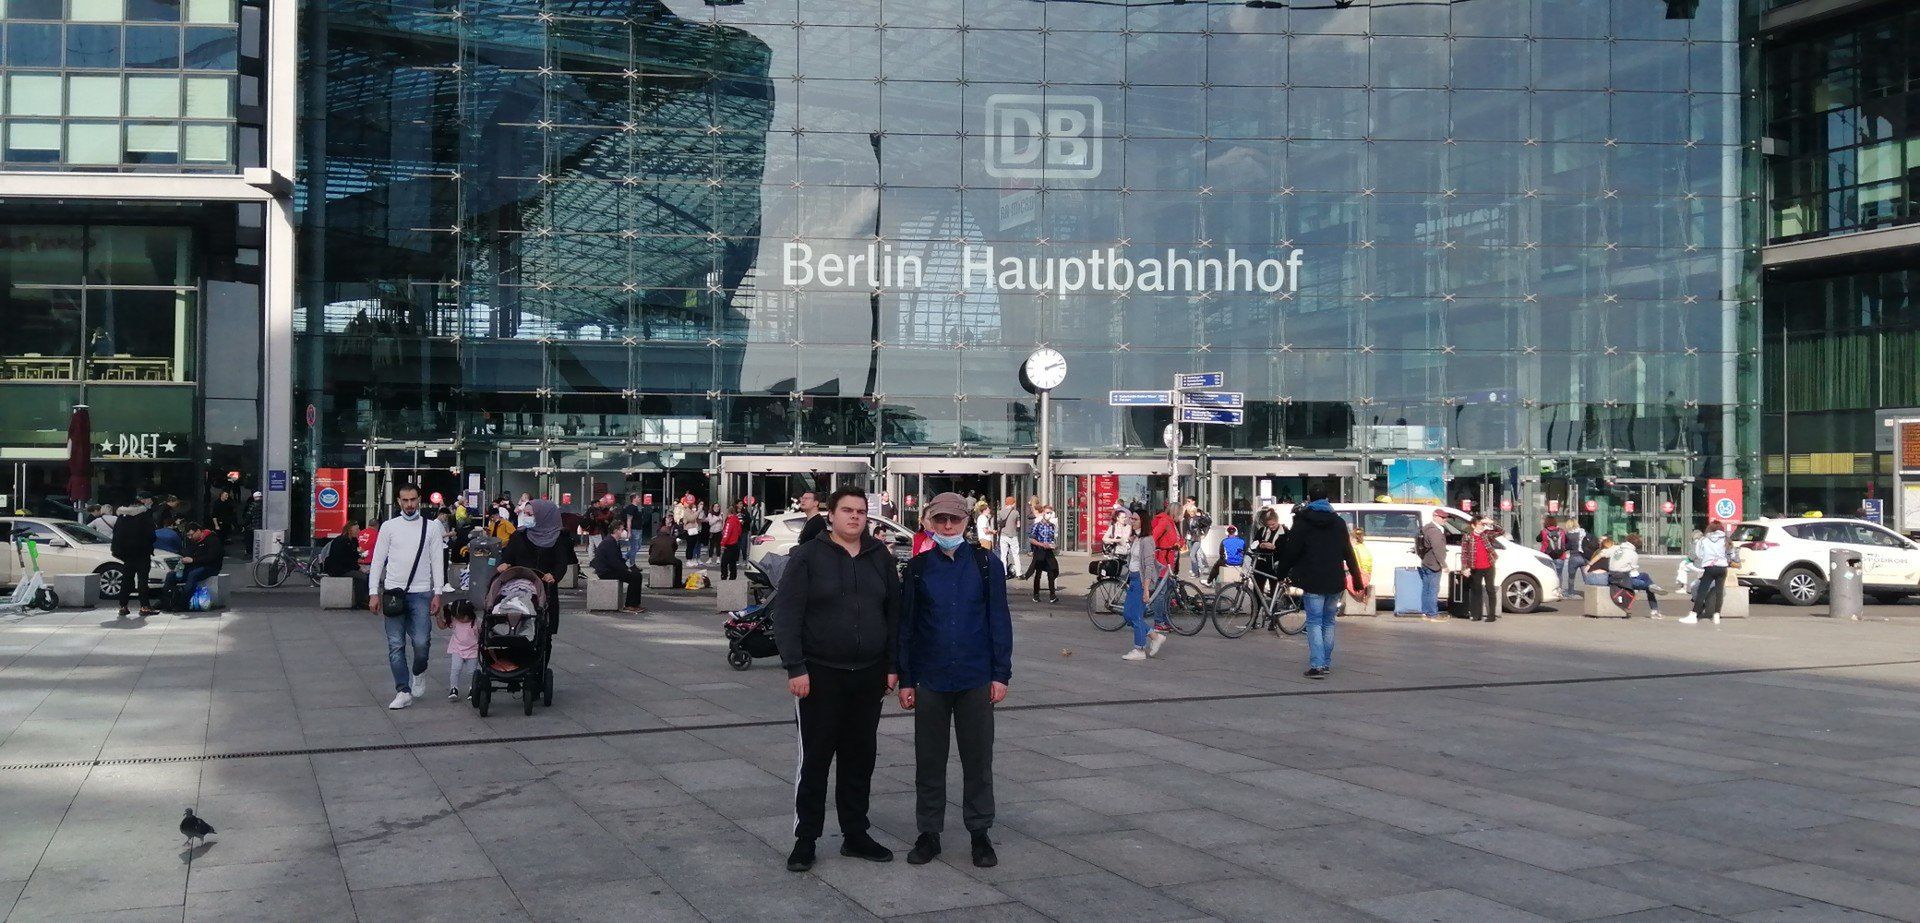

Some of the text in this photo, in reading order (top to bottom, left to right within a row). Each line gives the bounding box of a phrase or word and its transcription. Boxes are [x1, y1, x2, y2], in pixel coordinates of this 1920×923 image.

[998, 107, 1089, 167] DB
[783, 243, 1303, 300] Berlin Hauptbahnhof
[119, 433, 160, 459] PRET
